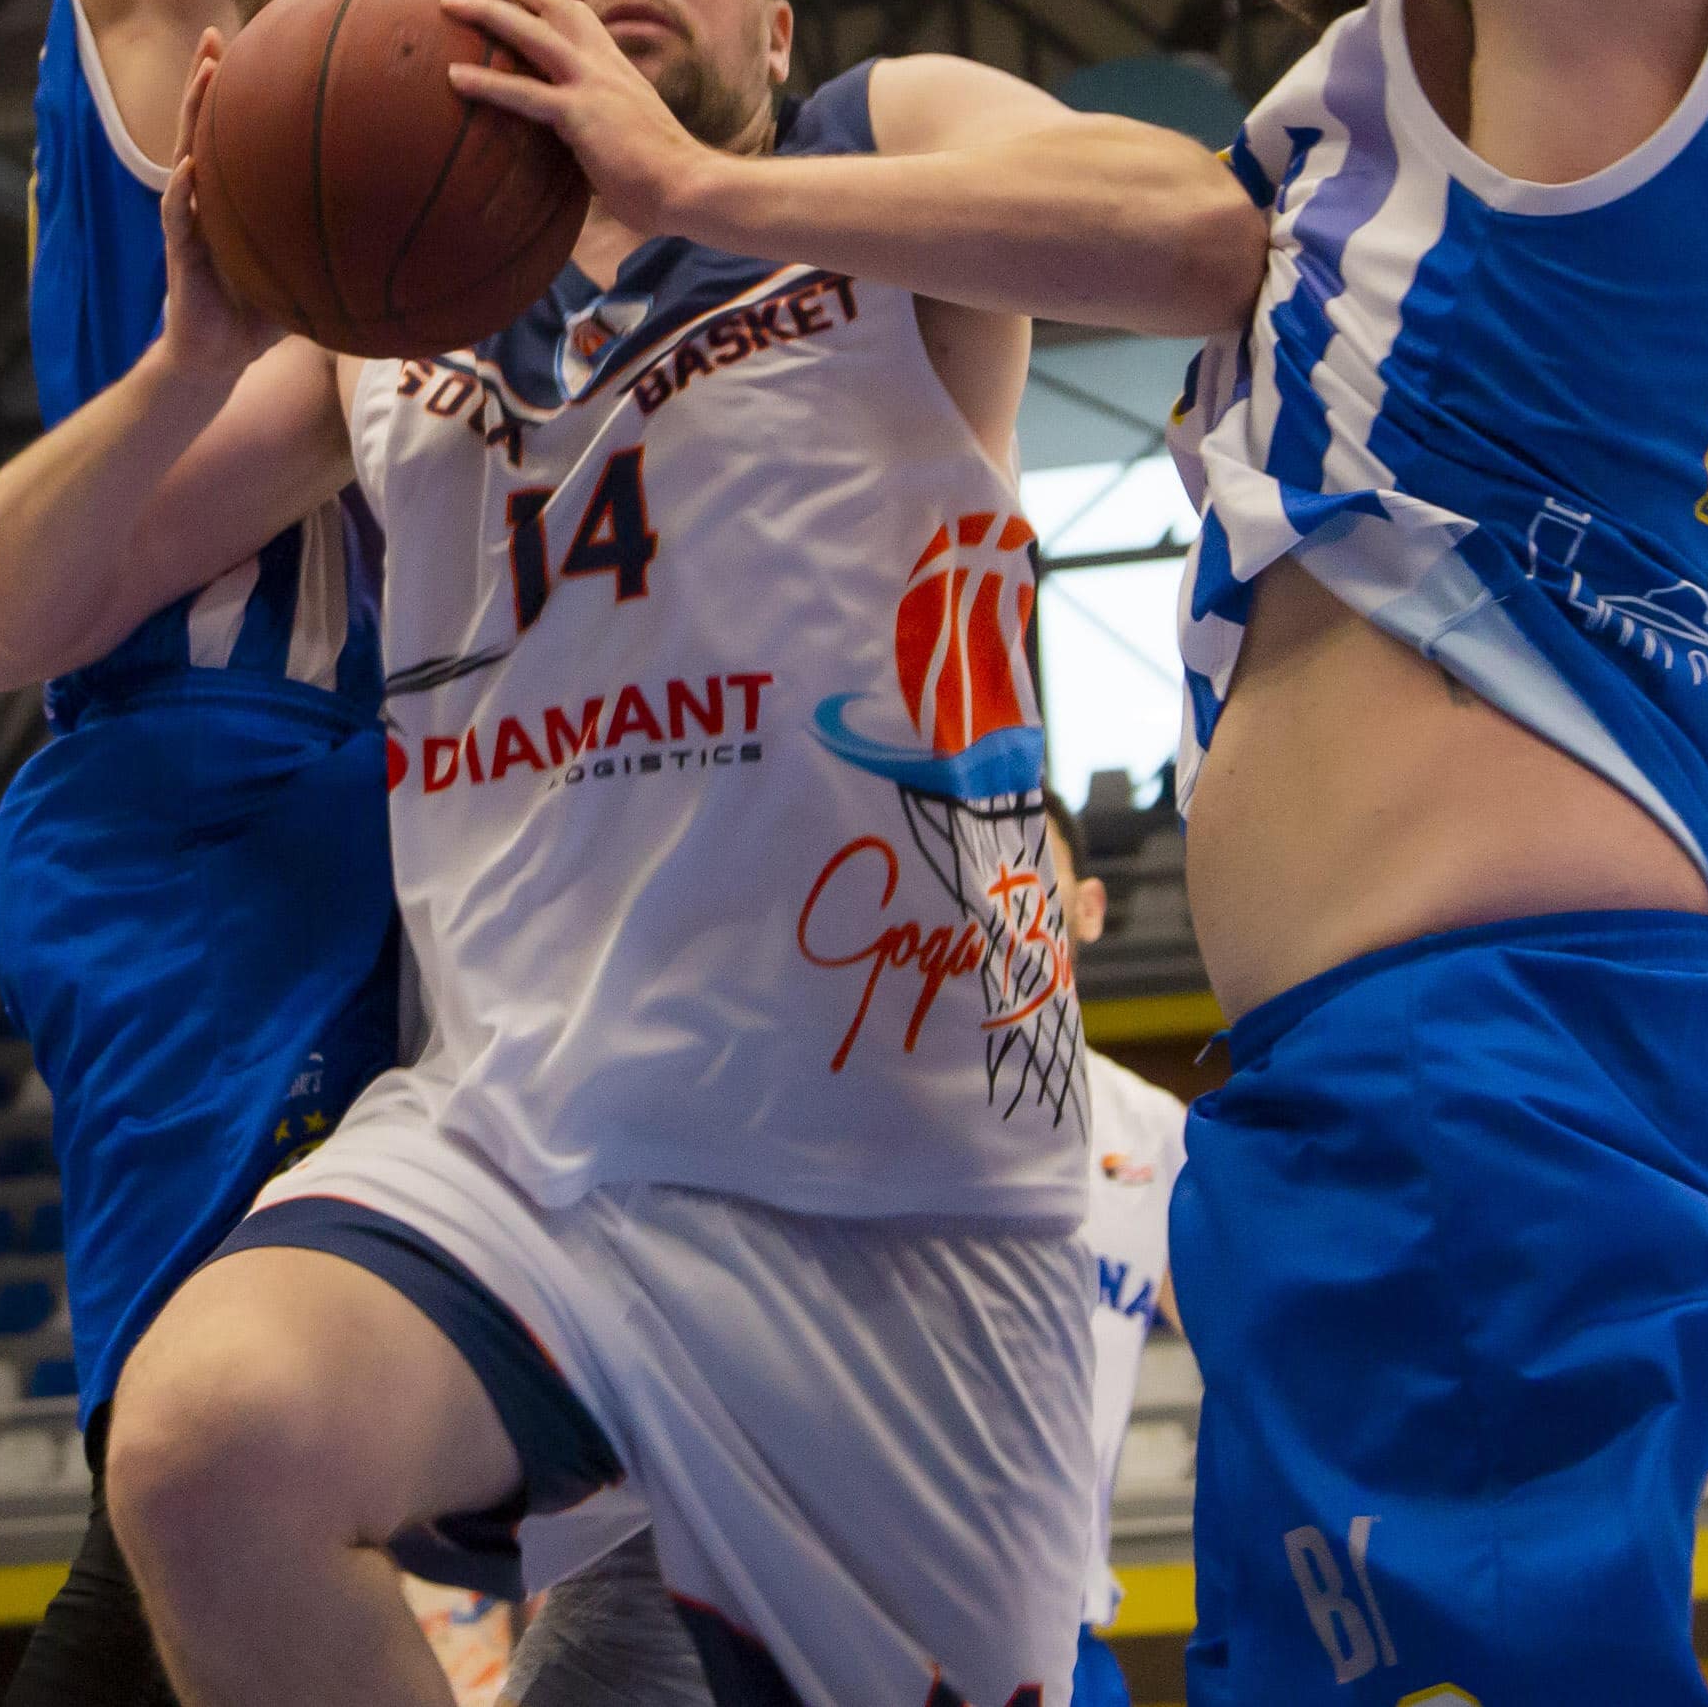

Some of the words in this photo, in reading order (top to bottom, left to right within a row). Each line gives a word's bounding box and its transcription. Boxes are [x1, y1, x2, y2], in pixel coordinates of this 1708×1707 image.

[630, 275, 860, 418] BASKET
[505, 444, 660, 635] 14
[422, 672, 774, 794] DIAMANT
